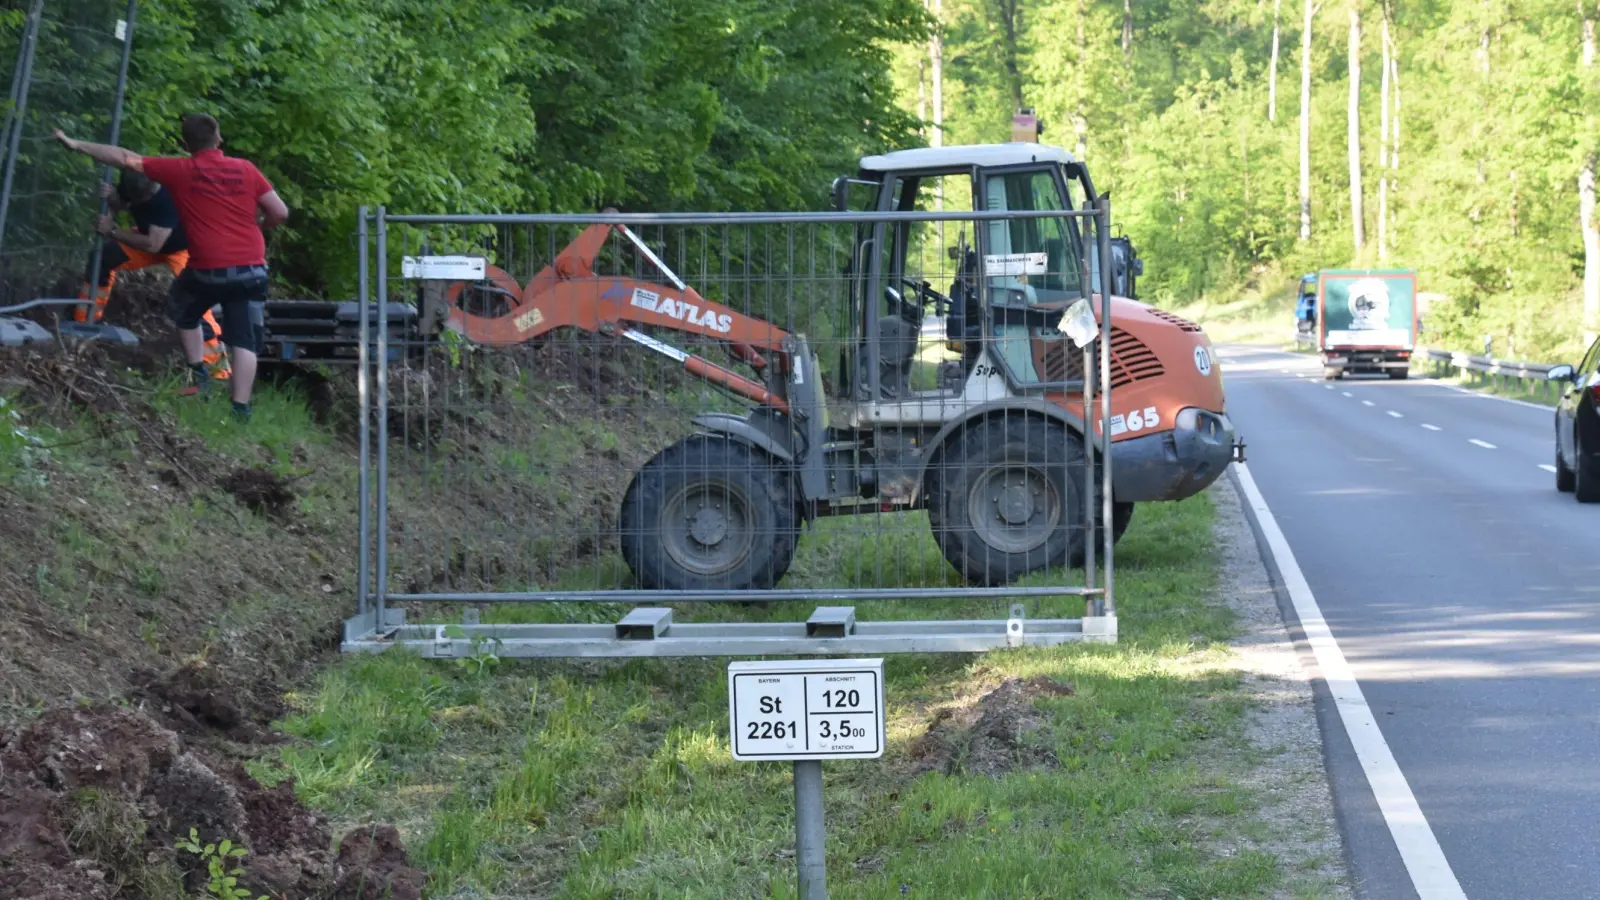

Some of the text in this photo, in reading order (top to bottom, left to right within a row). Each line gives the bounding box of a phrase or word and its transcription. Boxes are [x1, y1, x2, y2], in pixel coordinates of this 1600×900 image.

[656, 297, 733, 333] ATLAS
[1196, 350, 1209, 371] 20
[976, 364, 1002, 378] Sup
[759, 696, 782, 714] St
[822, 689, 860, 708] 120
[747, 721, 796, 739] 2261
